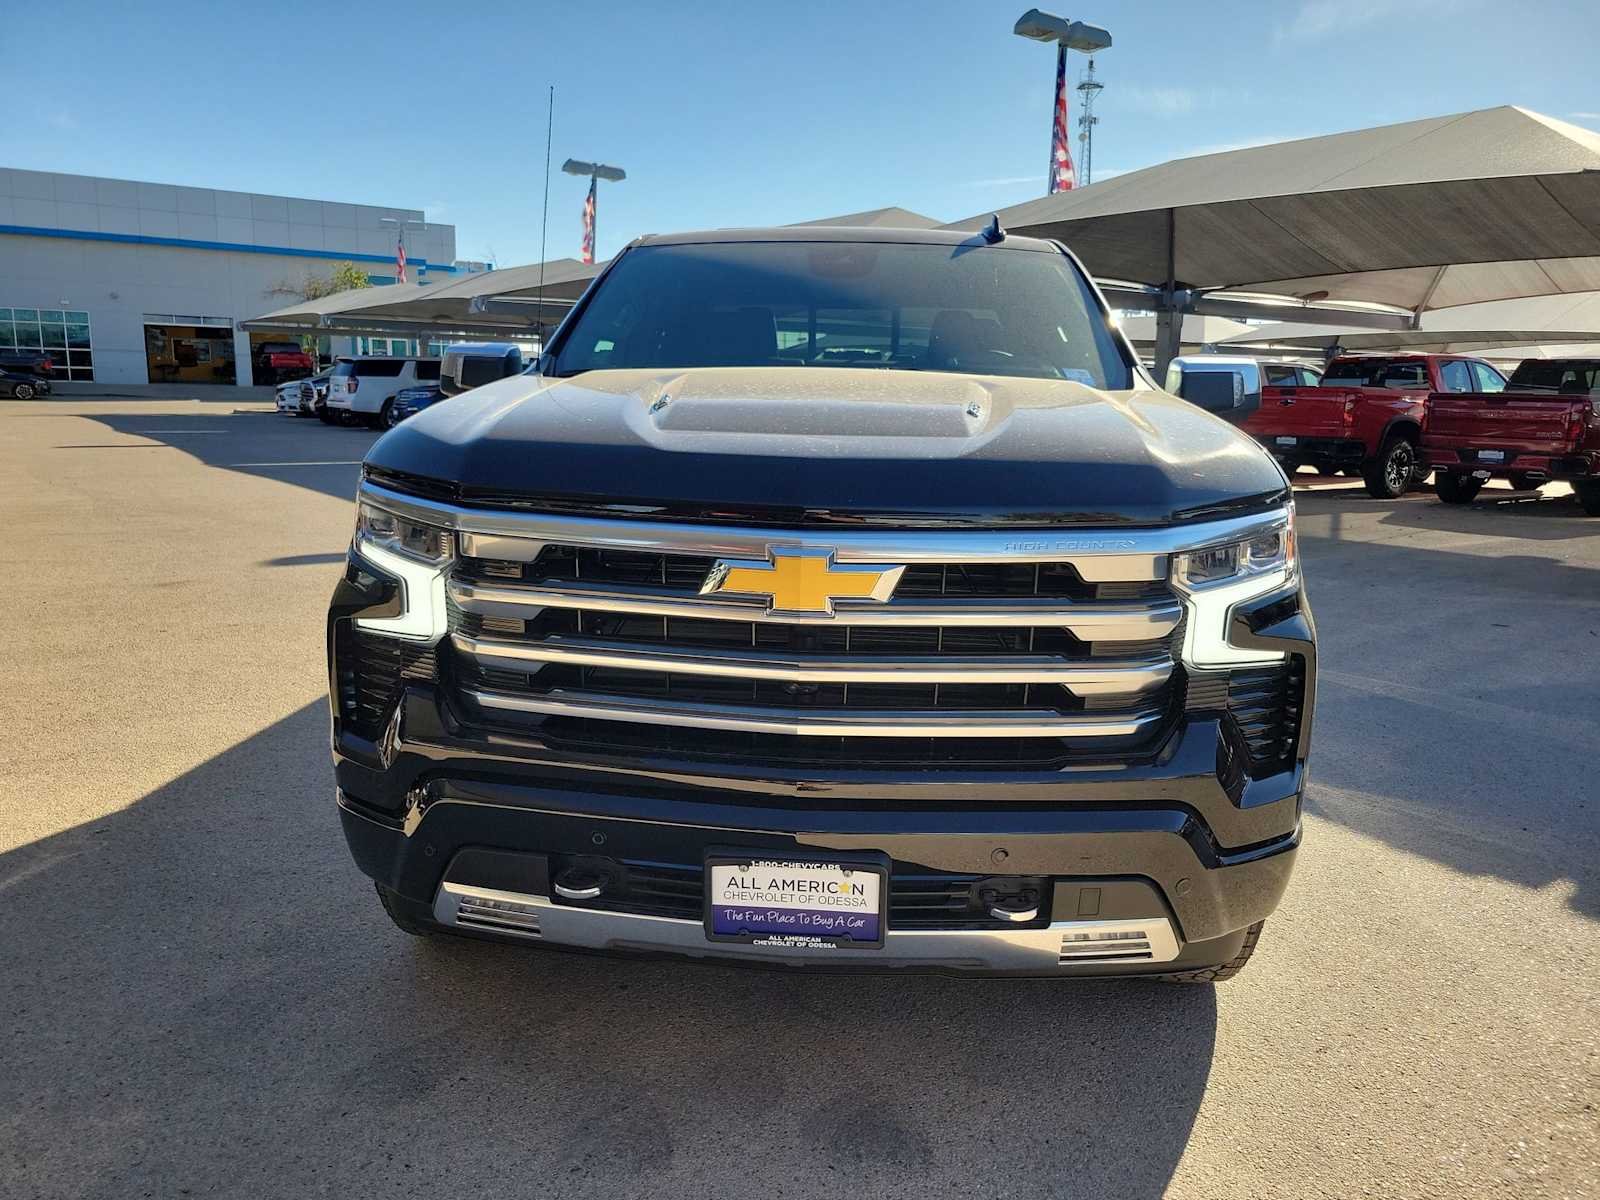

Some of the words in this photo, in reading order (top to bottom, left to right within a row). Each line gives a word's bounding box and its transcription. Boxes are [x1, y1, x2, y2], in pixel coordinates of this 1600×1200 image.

[1004, 541, 1049, 552] HIGH
[727, 876, 762, 890] ALL
[723, 890, 796, 903] CHEVROLET
[798, 894, 815, 905] OF
[818, 895, 867, 908] ODESSA
[723, 909, 744, 921] The
[744, 910, 765, 922] Fun
[766, 910, 796, 923] Place
[797, 912, 810, 924] To
[812, 914, 834, 930] Buy
[834, 916, 845, 927] A
[846, 916, 866, 928] Car
[752, 939, 795, 947] CHEVROLET
